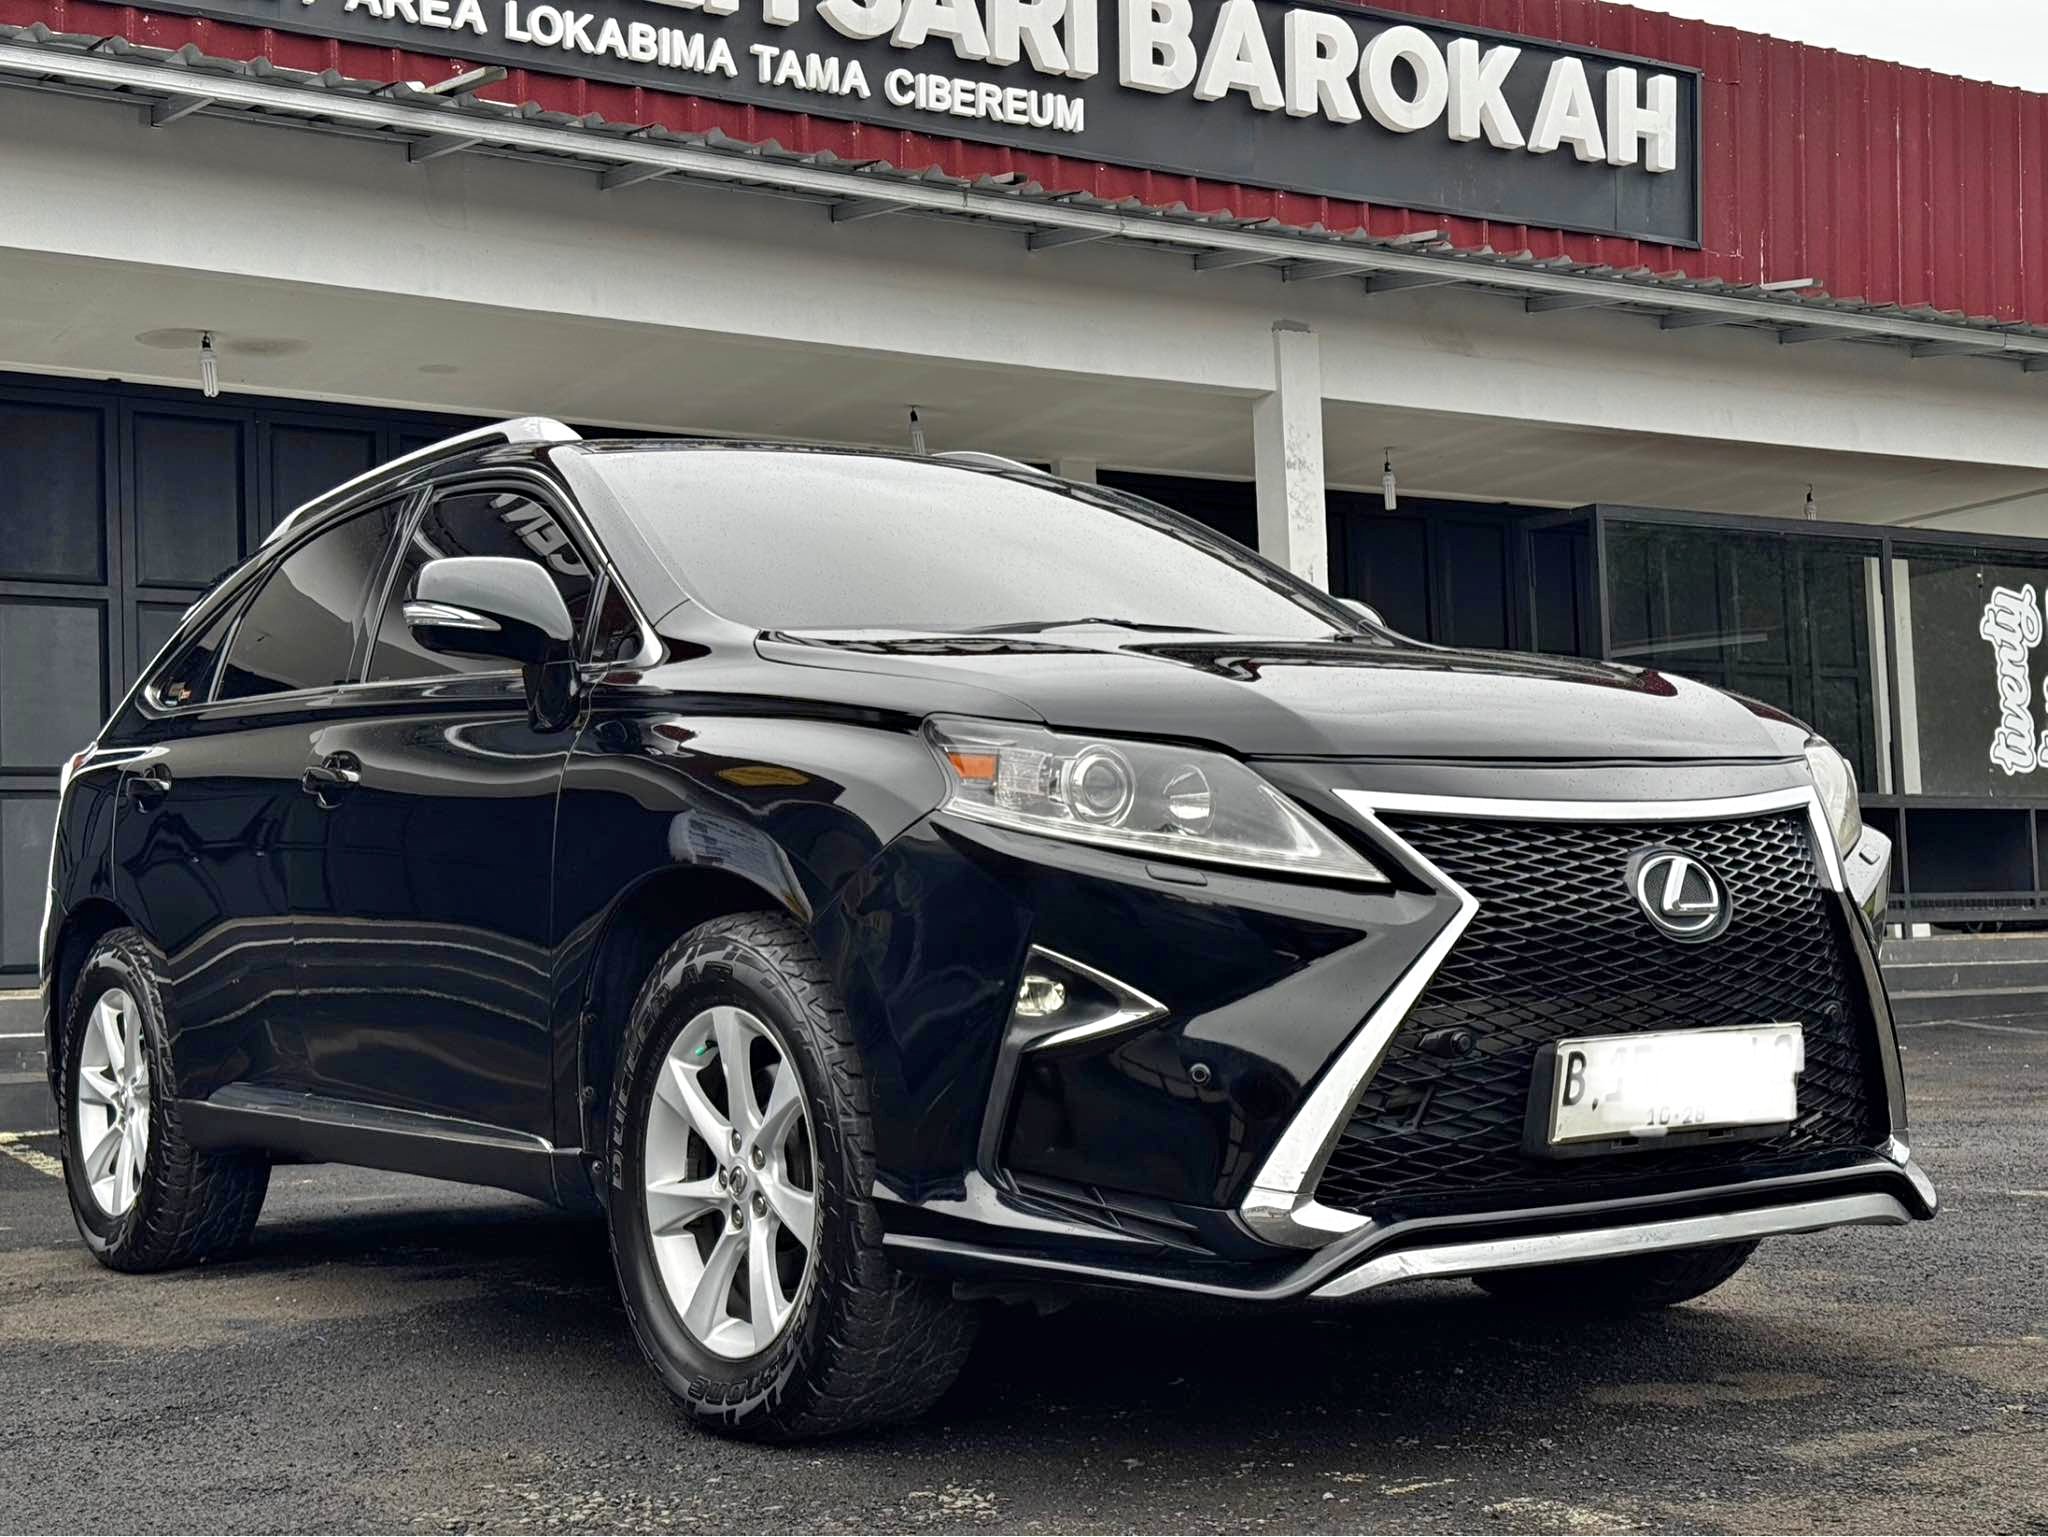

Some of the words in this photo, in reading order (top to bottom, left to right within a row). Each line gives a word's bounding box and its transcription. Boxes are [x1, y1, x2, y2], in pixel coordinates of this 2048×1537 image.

[504, 0, 739, 78] LOKABIMA
[750, 44, 871, 99] TAMA
[884, 68, 1085, 134] CIBEREUM
[1119, 0, 1677, 173] BAROKAH
[1980, 584, 2043, 776] twenty
[1562, 1050, 1587, 1107] B
